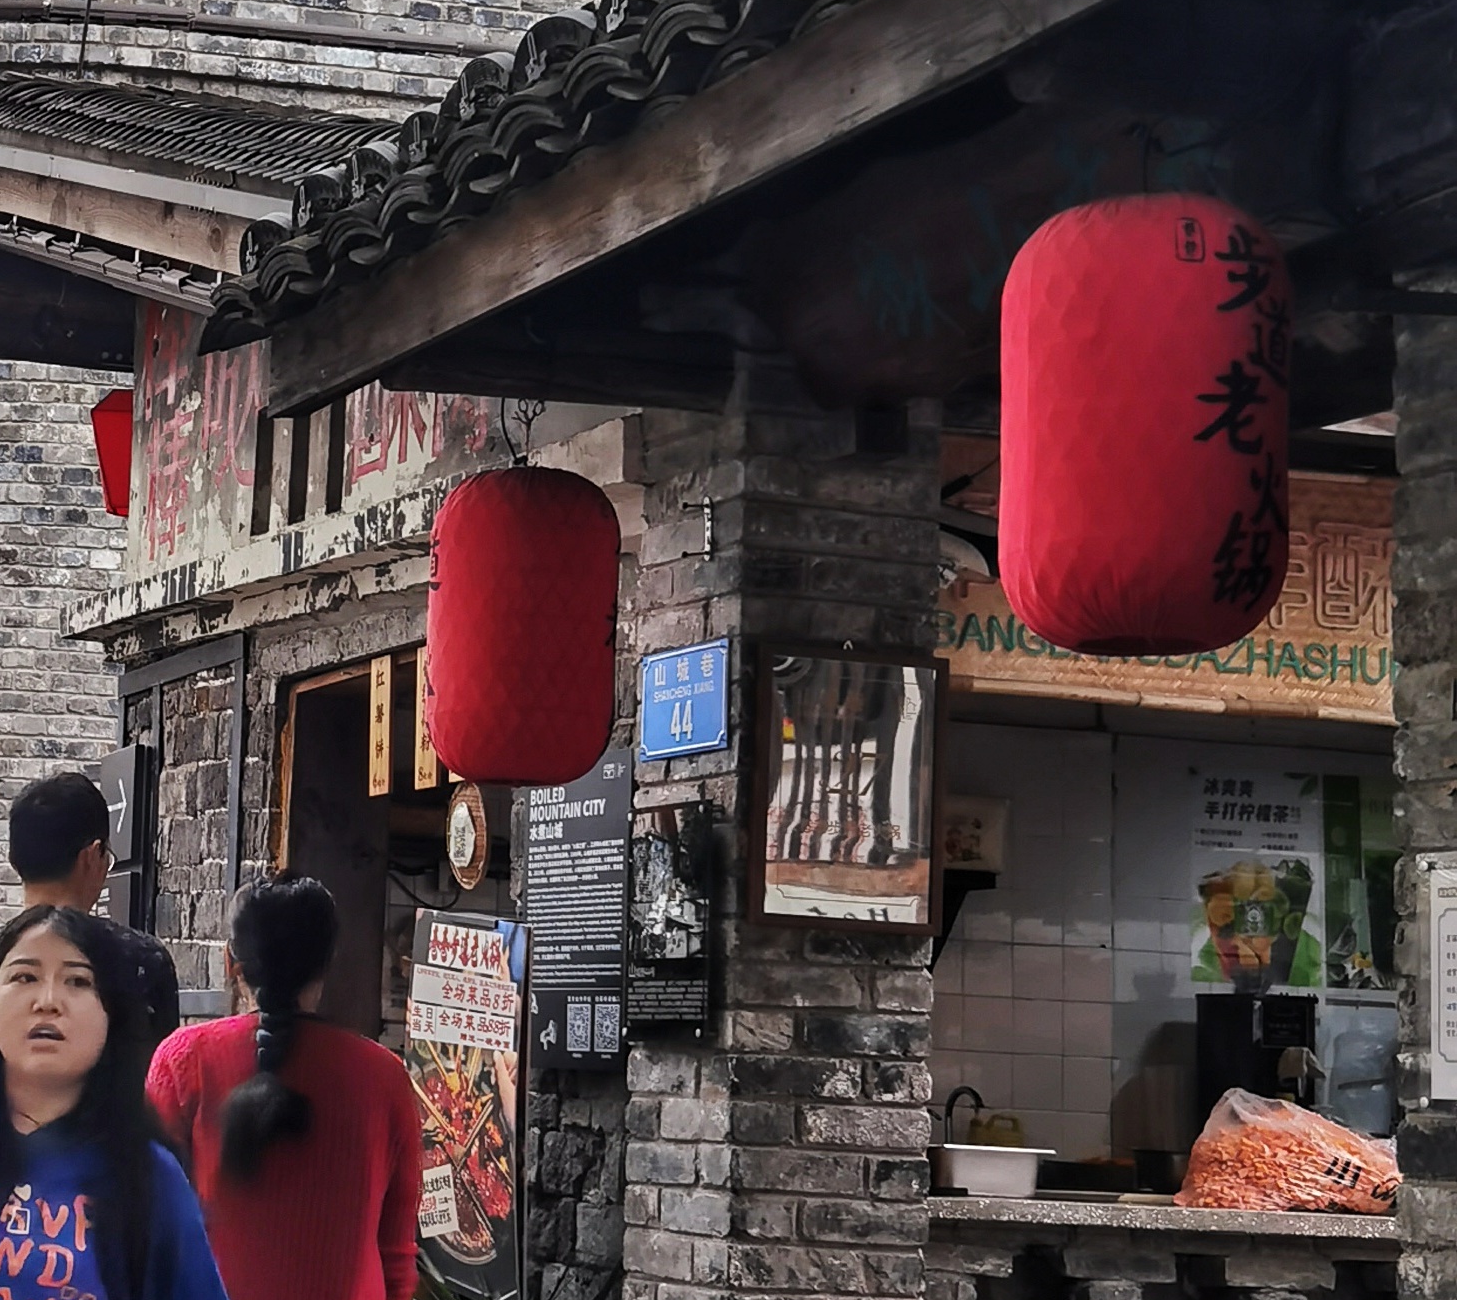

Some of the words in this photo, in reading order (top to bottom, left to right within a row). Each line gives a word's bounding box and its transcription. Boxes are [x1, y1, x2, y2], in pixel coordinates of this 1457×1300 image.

[653, 651, 714, 688] 山城巷
[653, 684, 692, 704] SHANCHENG
[694, 680, 715, 696] XIANG
[670, 699, 693, 742] 44
[530, 786, 565, 806] BOILED
[1203, 777, 1254, 798] 冰爽爽
[529, 801, 582, 822] MOUNTAIN
[583, 798, 606, 817] CITY
[1204, 801, 1289, 824] 手打柠檬茶
[529, 821, 563, 841] 水煮山城
[441, 980, 514, 1013] 全场菜品8折
